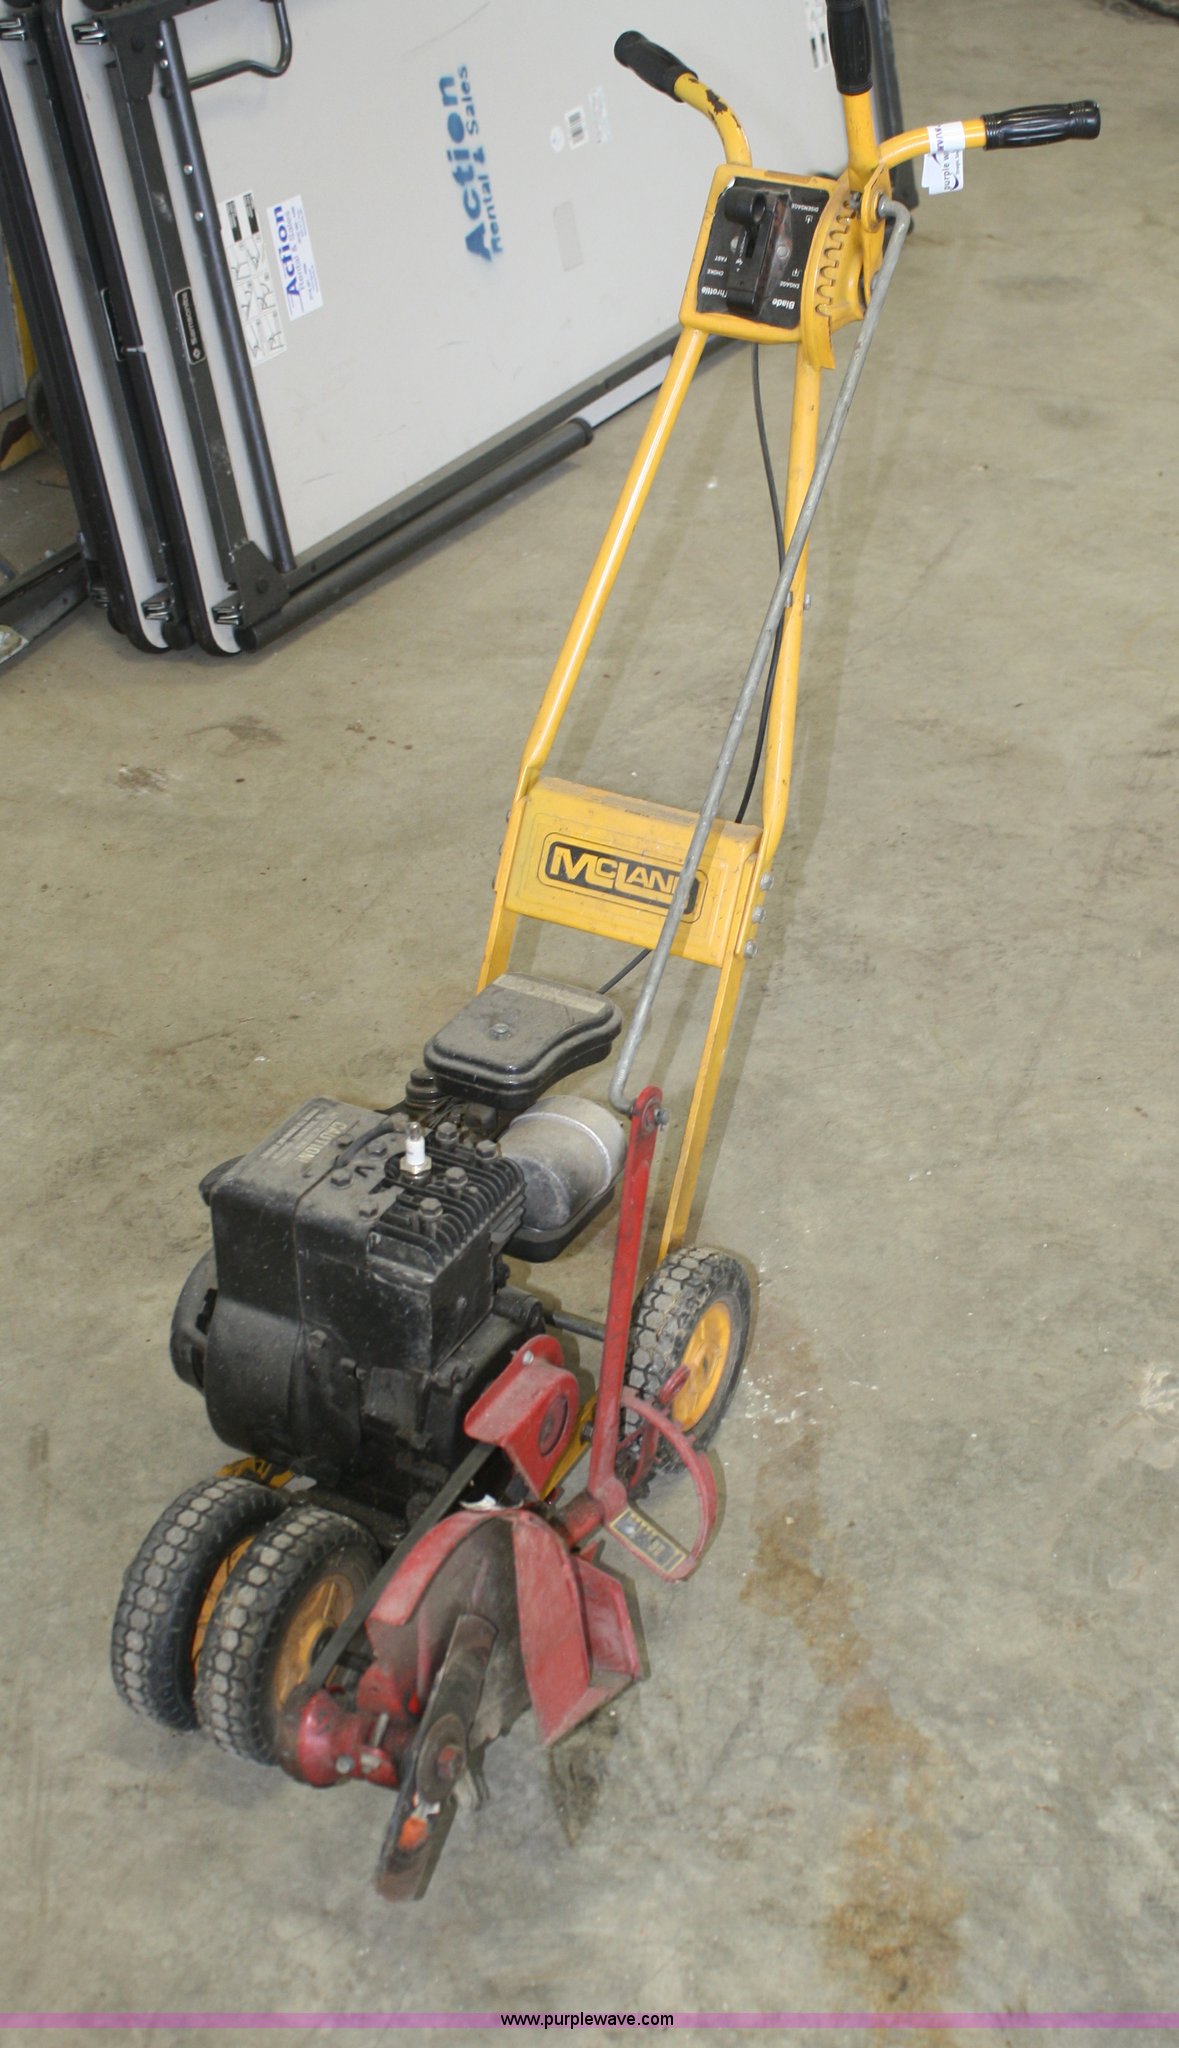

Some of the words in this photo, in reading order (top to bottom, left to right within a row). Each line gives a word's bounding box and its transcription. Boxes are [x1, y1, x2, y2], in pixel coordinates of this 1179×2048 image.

[458, 65, 478, 136] Sales
[438, 76, 492, 262] Action
[791, 202, 819, 212] DISENGAGE
[478, 174, 503, 253] Rental
[273, 205, 300, 296] Action
[714, 255, 728, 263] FAST
[779, 280, 800, 289] ENGAGE
[701, 286, 728, 298] Throttle
[772, 298, 796, 310] Blade
